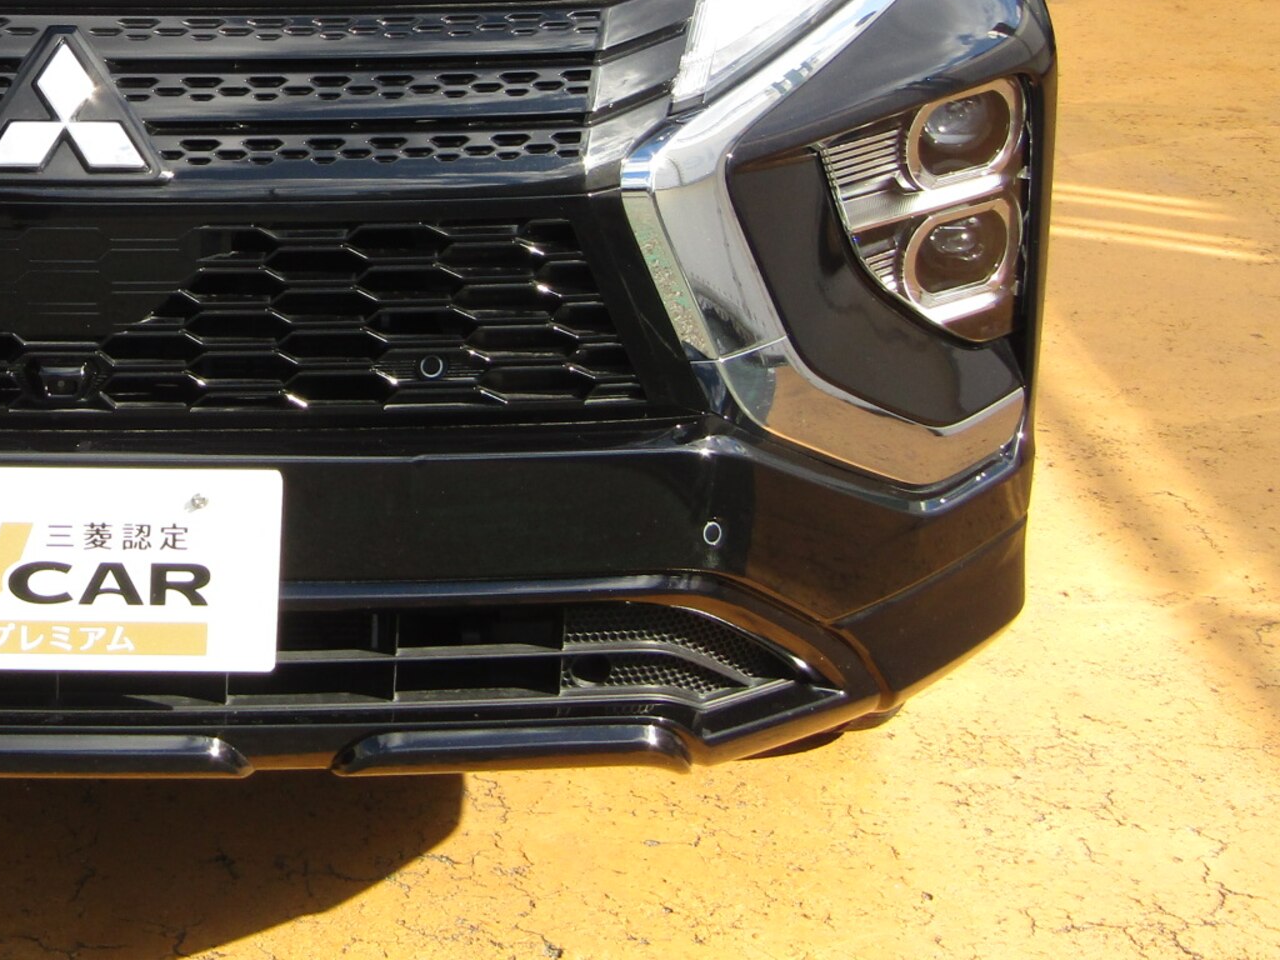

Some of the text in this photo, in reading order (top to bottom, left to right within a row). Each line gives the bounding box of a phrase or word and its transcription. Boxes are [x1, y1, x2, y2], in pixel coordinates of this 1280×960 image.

[46, 522, 188, 551] 三菱認定
[8, 561, 211, 606] CAR
